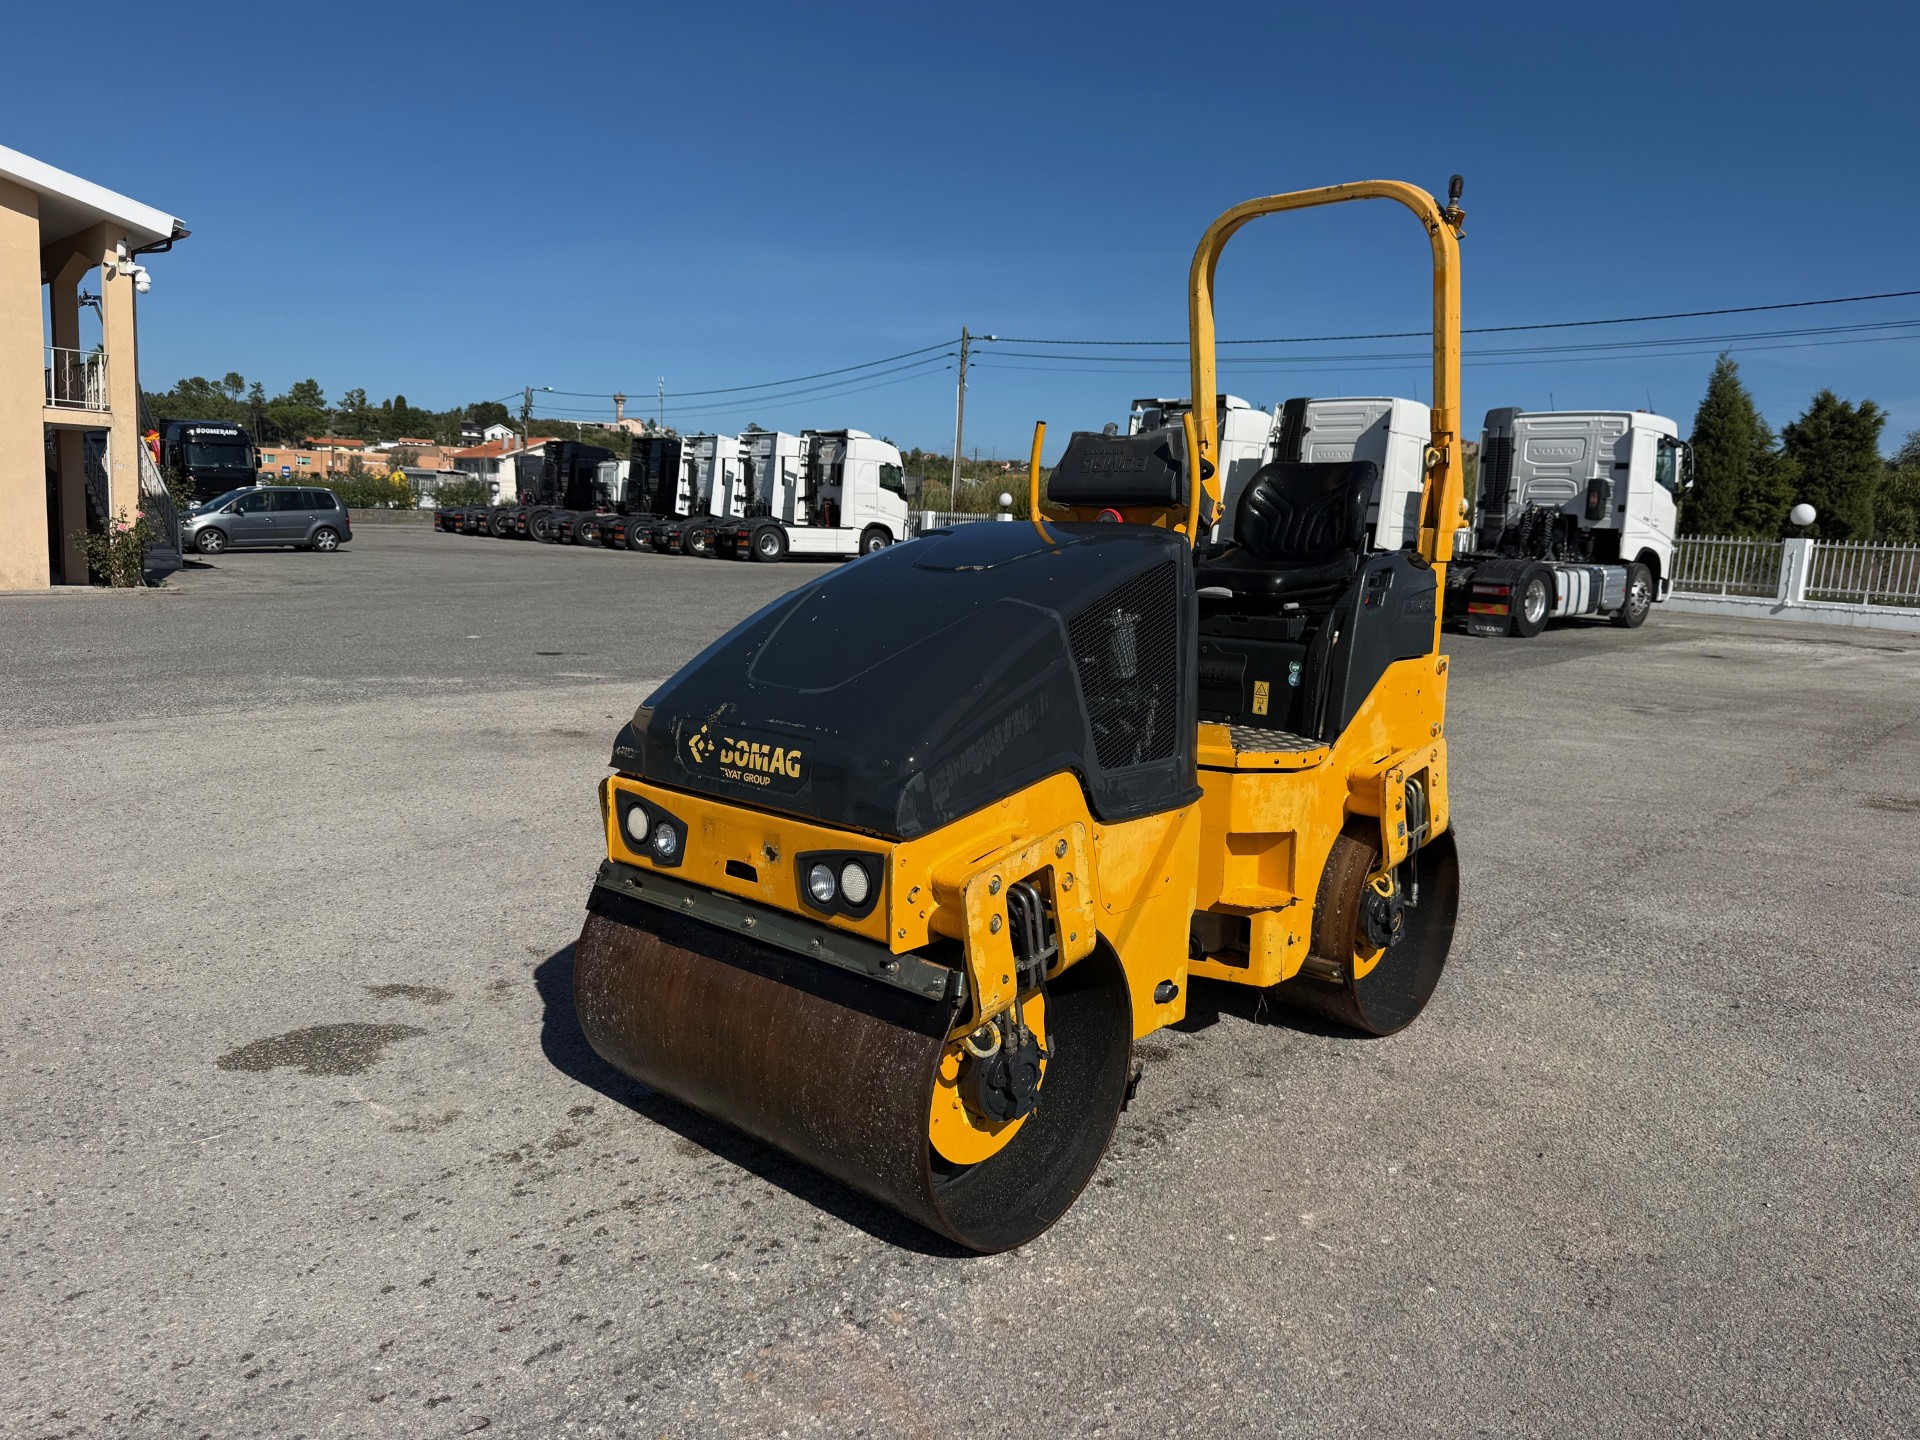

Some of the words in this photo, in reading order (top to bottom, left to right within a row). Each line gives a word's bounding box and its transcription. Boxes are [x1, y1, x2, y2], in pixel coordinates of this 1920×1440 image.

[1316, 450, 1353, 459] VOLVO
[1533, 447, 1577, 456] VOLVO
[1474, 624, 1504, 633] VOLVO
[720, 736, 802, 778] BOMAG
[743, 772, 771, 786] GROUP
